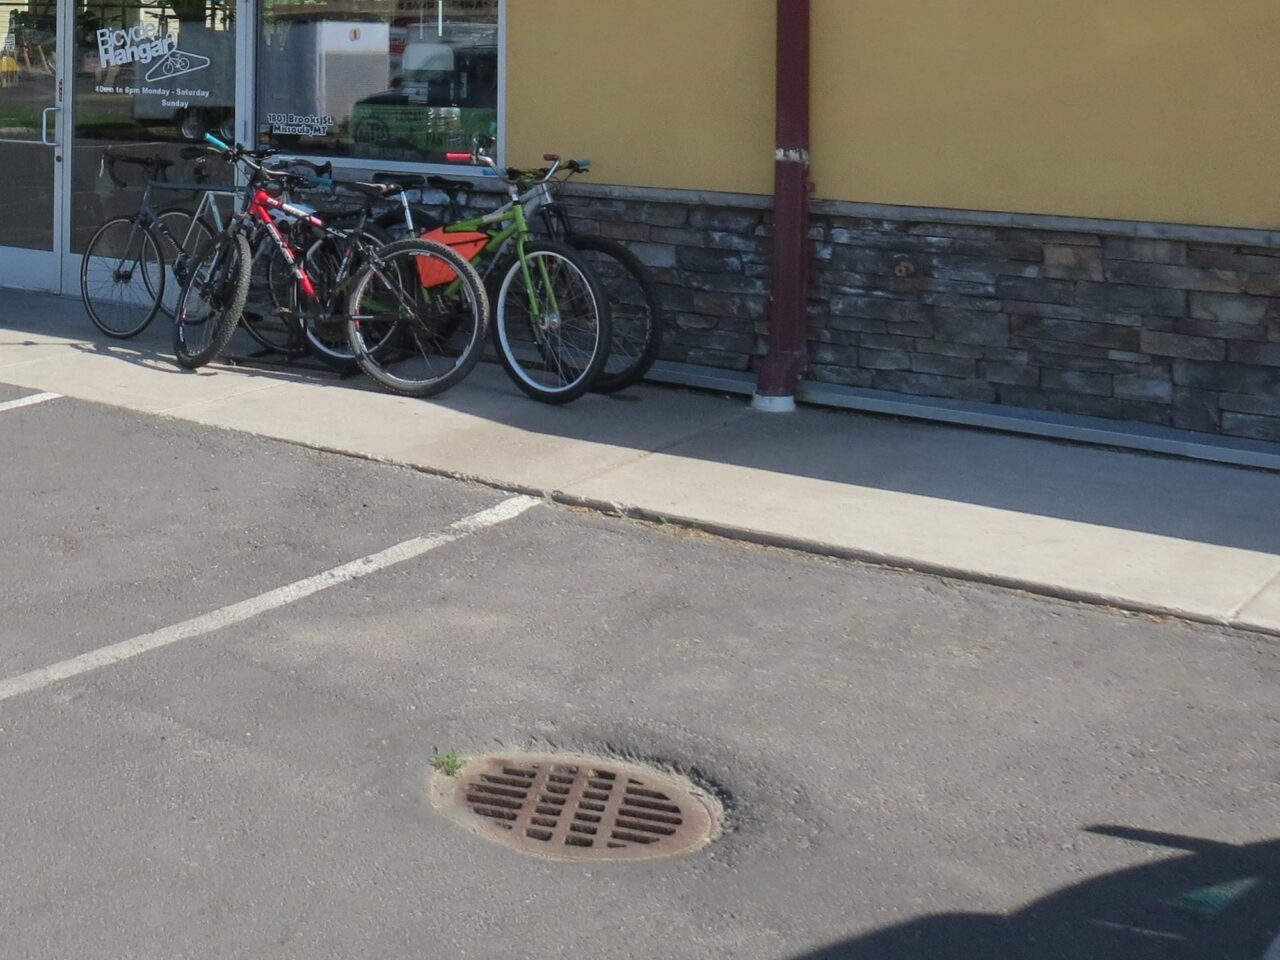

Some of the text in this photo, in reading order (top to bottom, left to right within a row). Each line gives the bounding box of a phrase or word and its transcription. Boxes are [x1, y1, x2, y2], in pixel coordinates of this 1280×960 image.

[96, 23, 156, 48] Bicycle
[99, 37, 173, 68] Hangar
[125, 87, 140, 95] 6pm
[142, 88, 170, 96] Monday
[176, 88, 210, 98] Saturday
[161, 99, 189, 109] Sunday
[267, 113, 287, 124] 1801
[288, 113, 321, 124] Brooks
